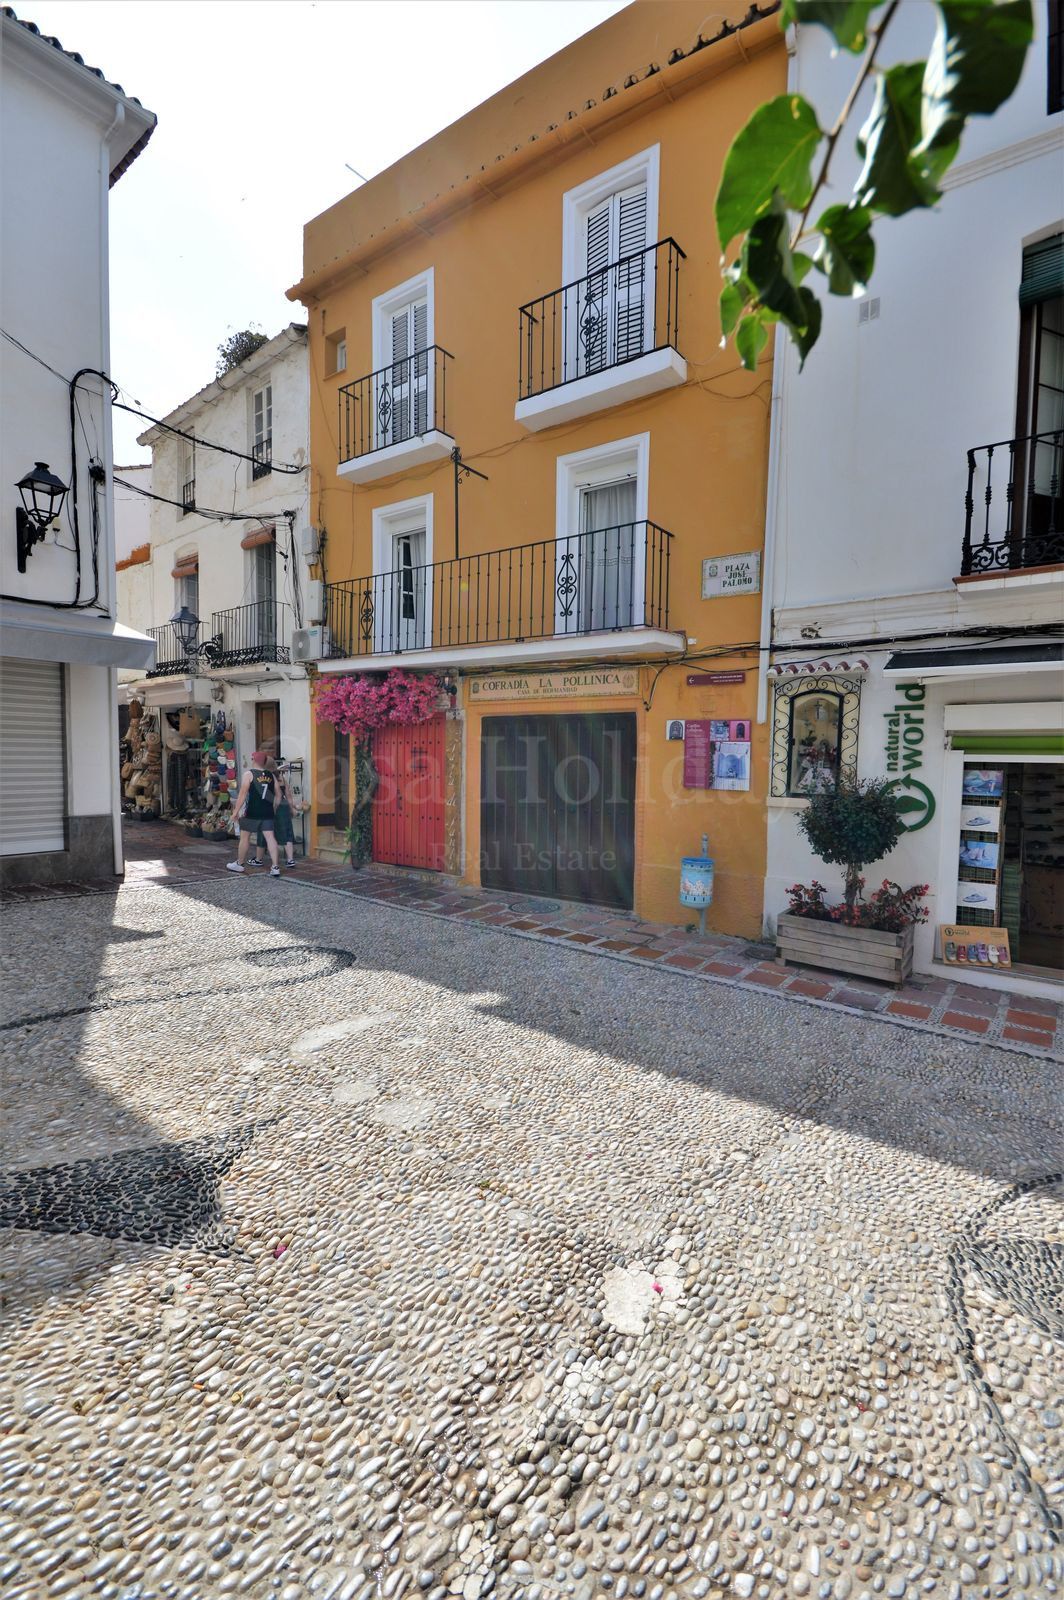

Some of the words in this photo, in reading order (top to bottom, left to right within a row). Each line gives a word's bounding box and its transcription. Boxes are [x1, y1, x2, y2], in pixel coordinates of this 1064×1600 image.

[725, 563, 750, 572] PLAZA
[722, 577, 752, 587] PALOMO
[539, 678, 552, 688] LA
[894, 683, 926, 772] world
[883, 713, 900, 772] natural
[261, 783, 268, 800] 7
